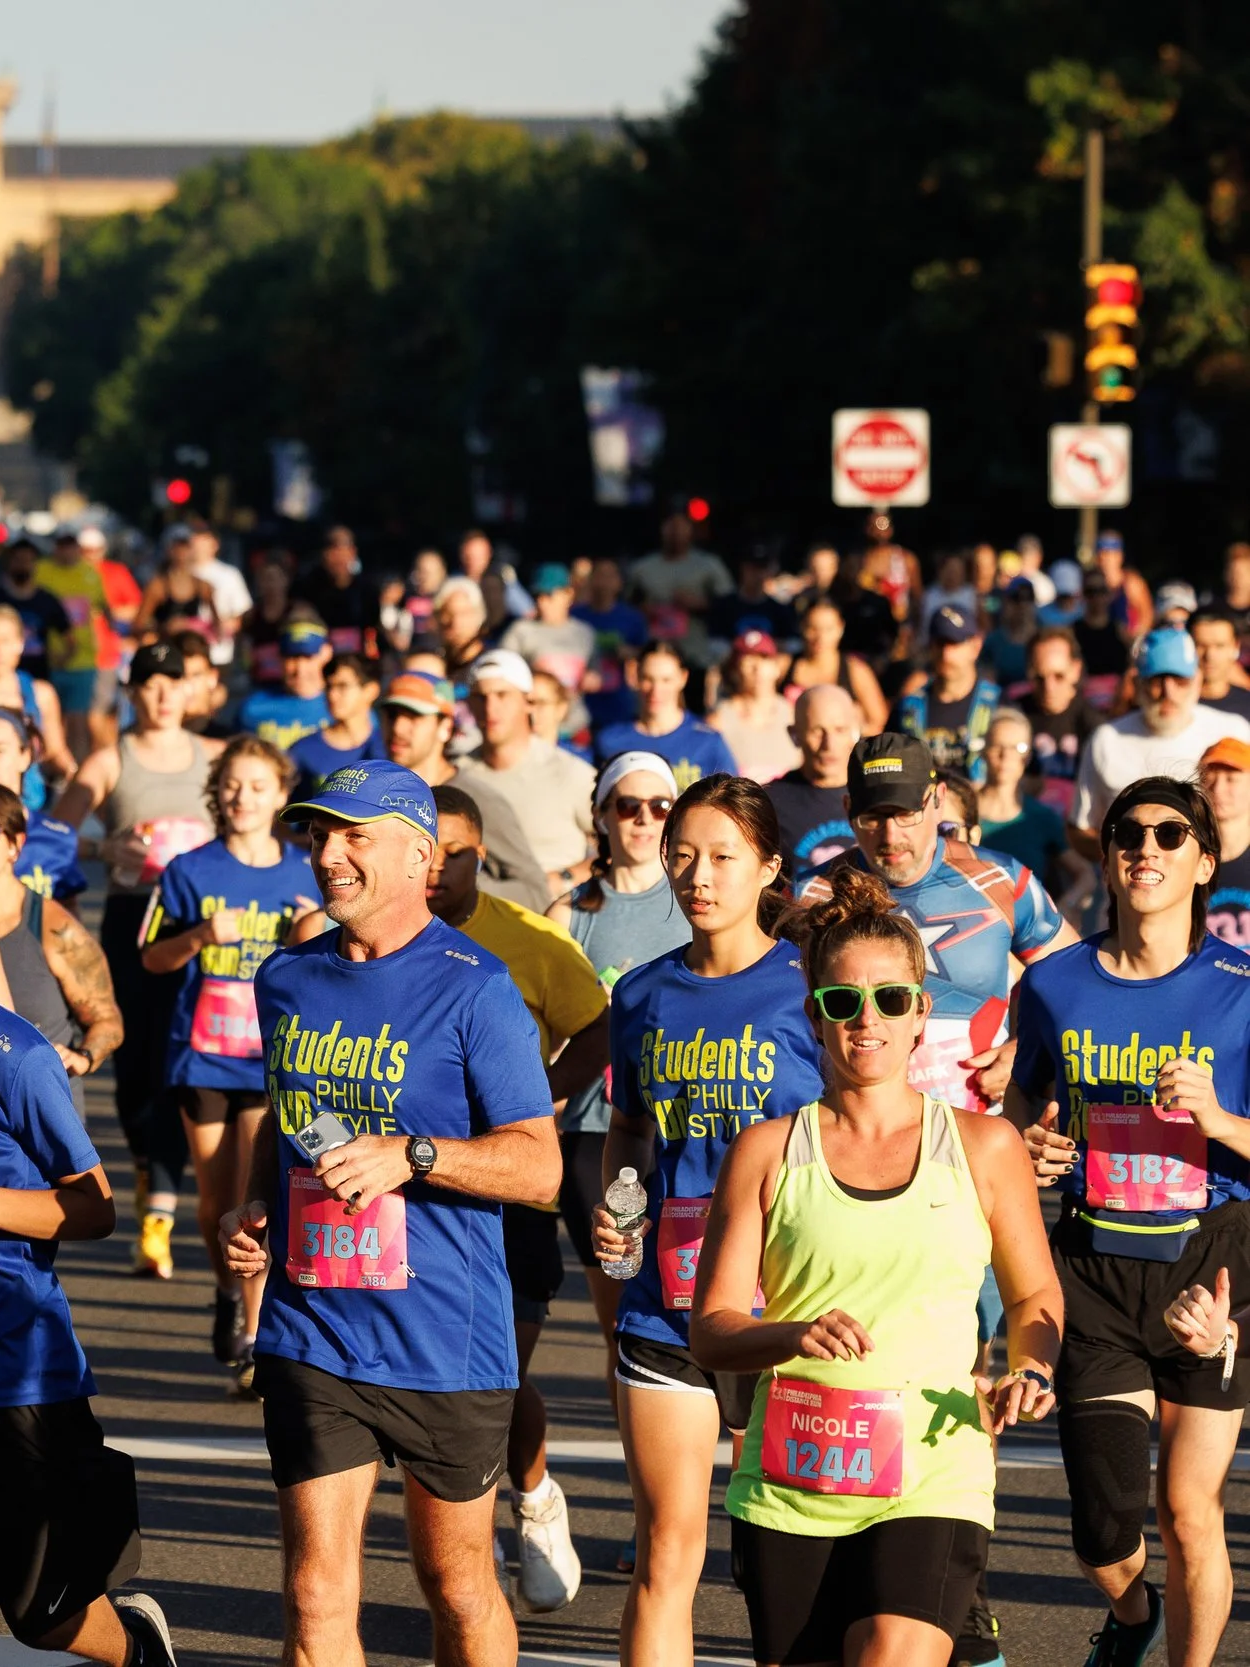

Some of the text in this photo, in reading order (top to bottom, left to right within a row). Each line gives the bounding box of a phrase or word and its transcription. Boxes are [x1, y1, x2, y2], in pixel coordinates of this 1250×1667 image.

[269, 1014, 410, 1083] Students
[640, 1023, 777, 1087] Students
[316, 1079, 403, 1114] PHILLY
[687, 1083, 772, 1111] PHILLY
[1107, 1153, 1185, 1185] 3182
[302, 1222, 383, 1260] 3184
[361, 1274, 387, 1287] 3184
[791, 1411, 870, 1439] NICOLE
[785, 1438, 875, 1485] 1244
